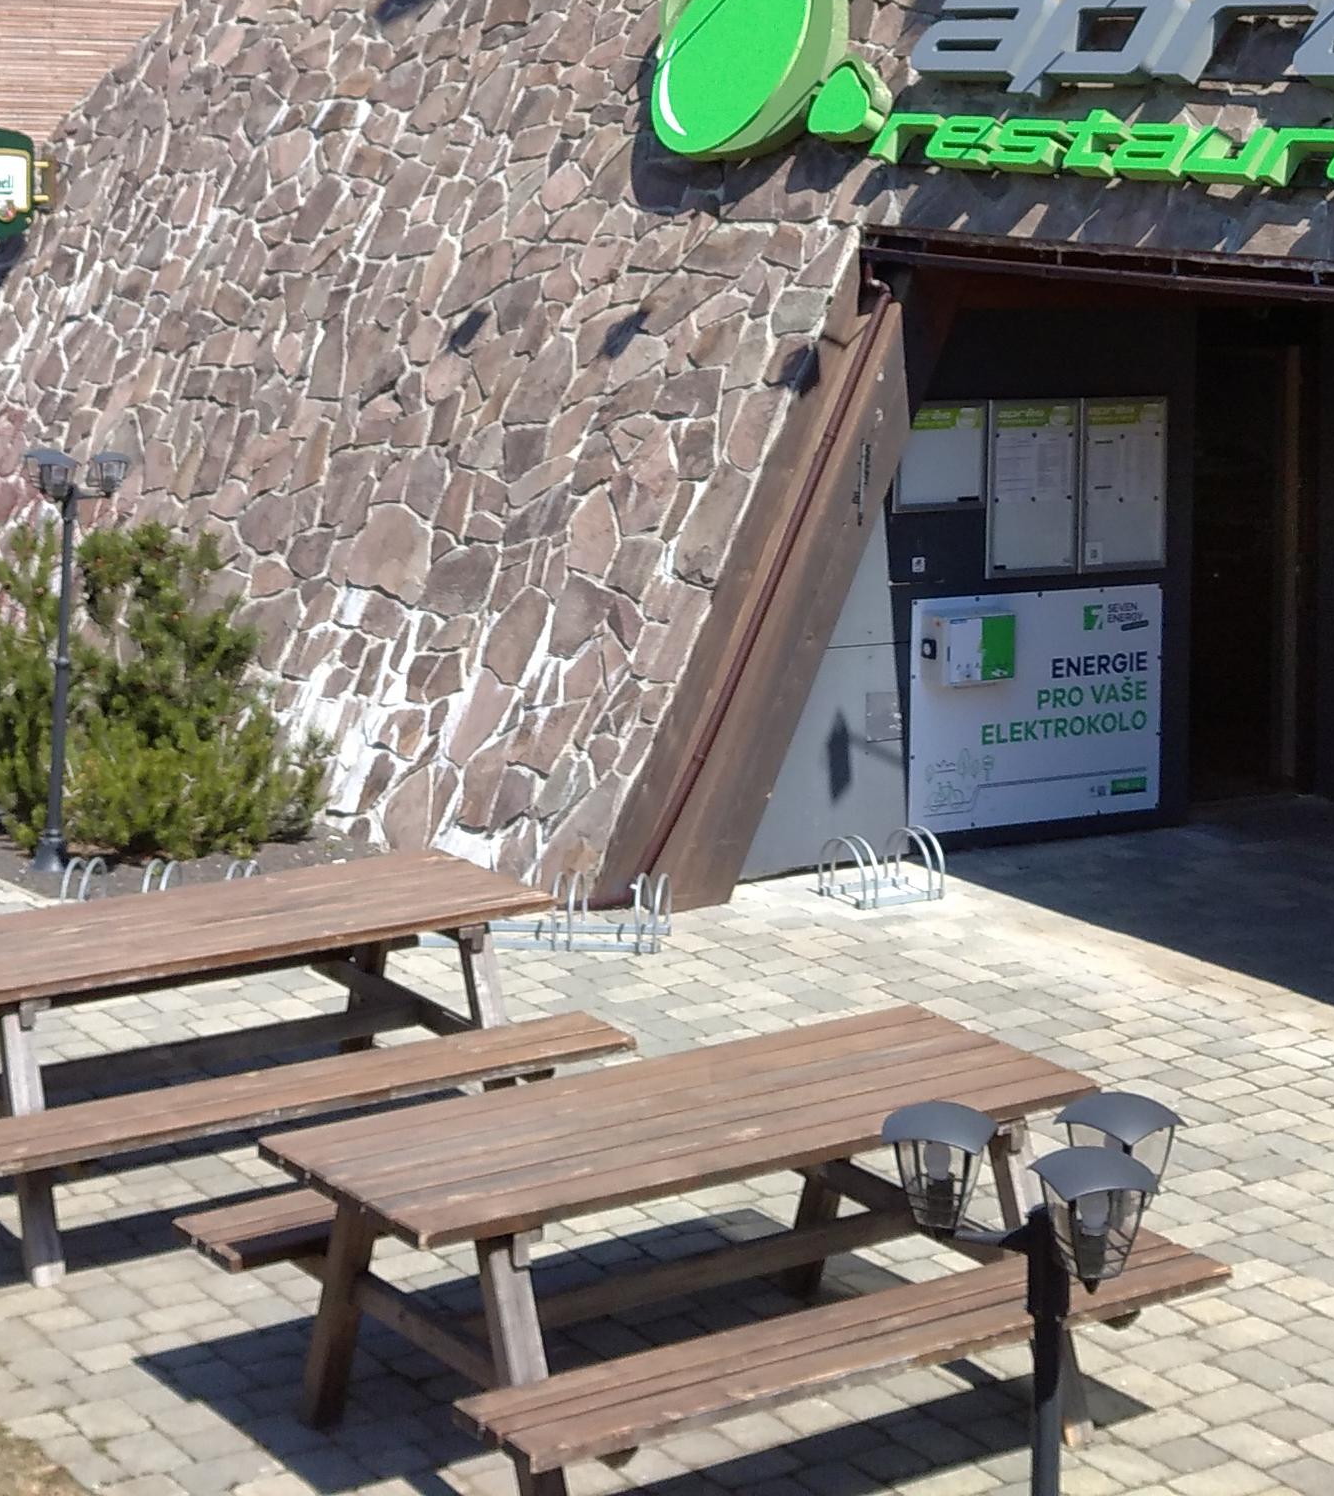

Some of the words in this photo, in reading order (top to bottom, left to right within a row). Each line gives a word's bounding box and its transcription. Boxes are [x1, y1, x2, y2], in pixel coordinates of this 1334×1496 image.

[1051, 651, 1148, 679] ENERGIE
[1037, 686, 1084, 710] PRO
[1091, 675, 1147, 705] VAŠE
[981, 710, 1147, 745] ELEKTROKOLO
